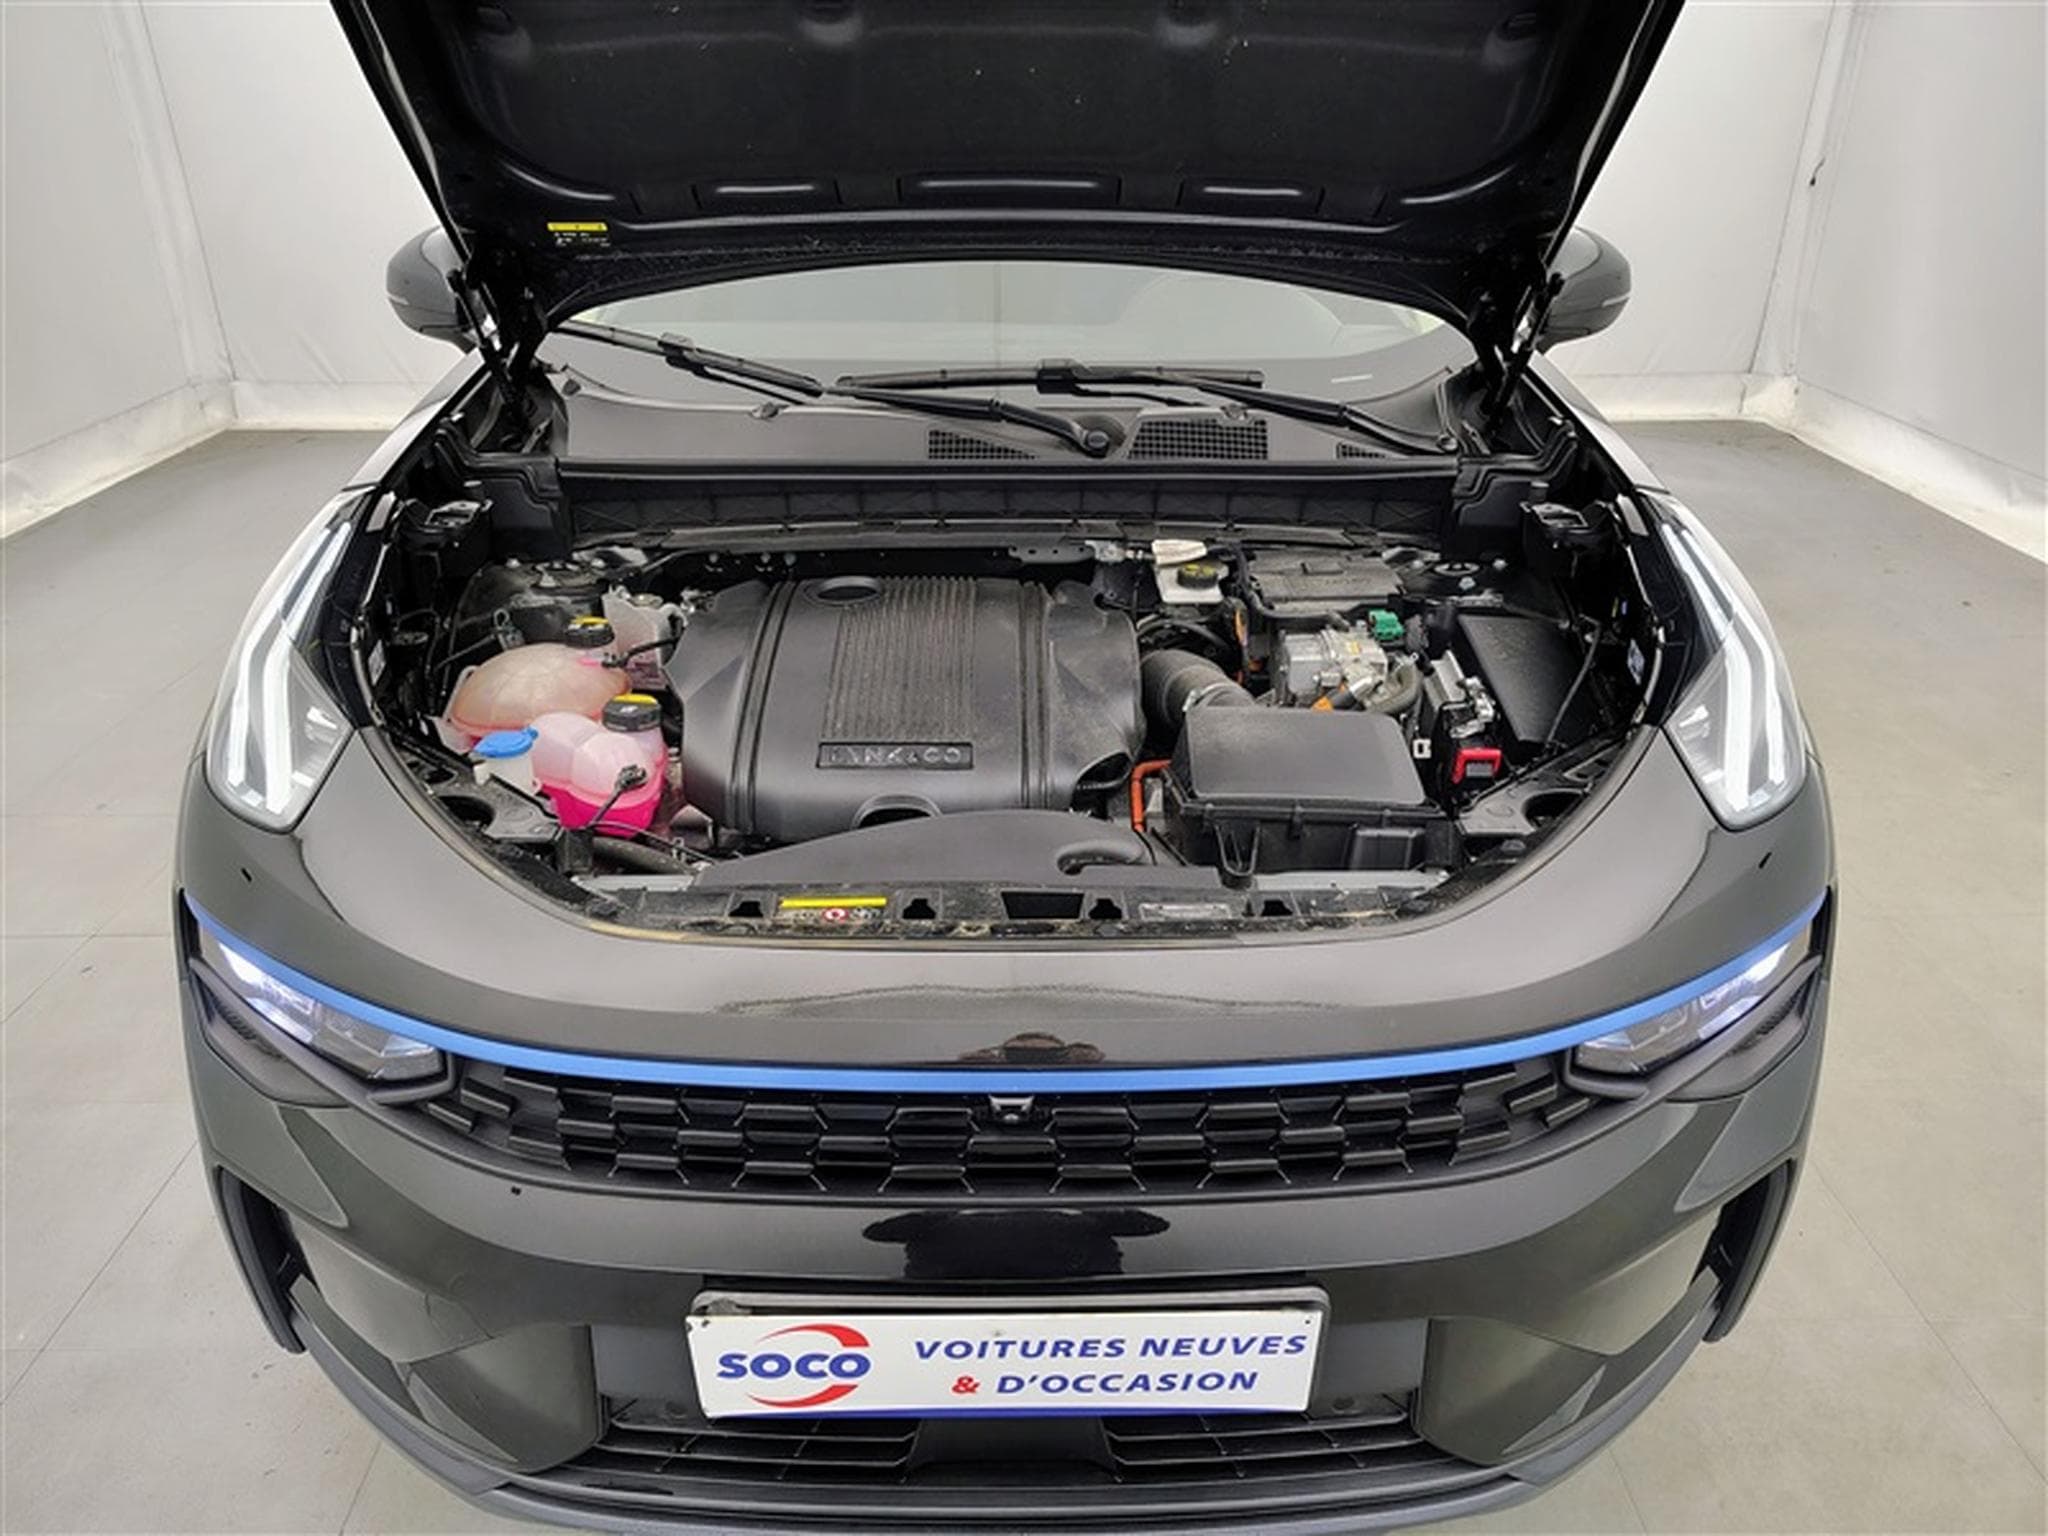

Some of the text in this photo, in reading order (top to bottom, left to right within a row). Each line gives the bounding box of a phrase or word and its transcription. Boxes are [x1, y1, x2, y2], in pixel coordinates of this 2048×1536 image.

[914, 1335, 1308, 1359] VOITURES NEUVES
[716, 1352, 871, 1379] SOCO
[951, 1371, 1258, 1394] & D'OCCASION
